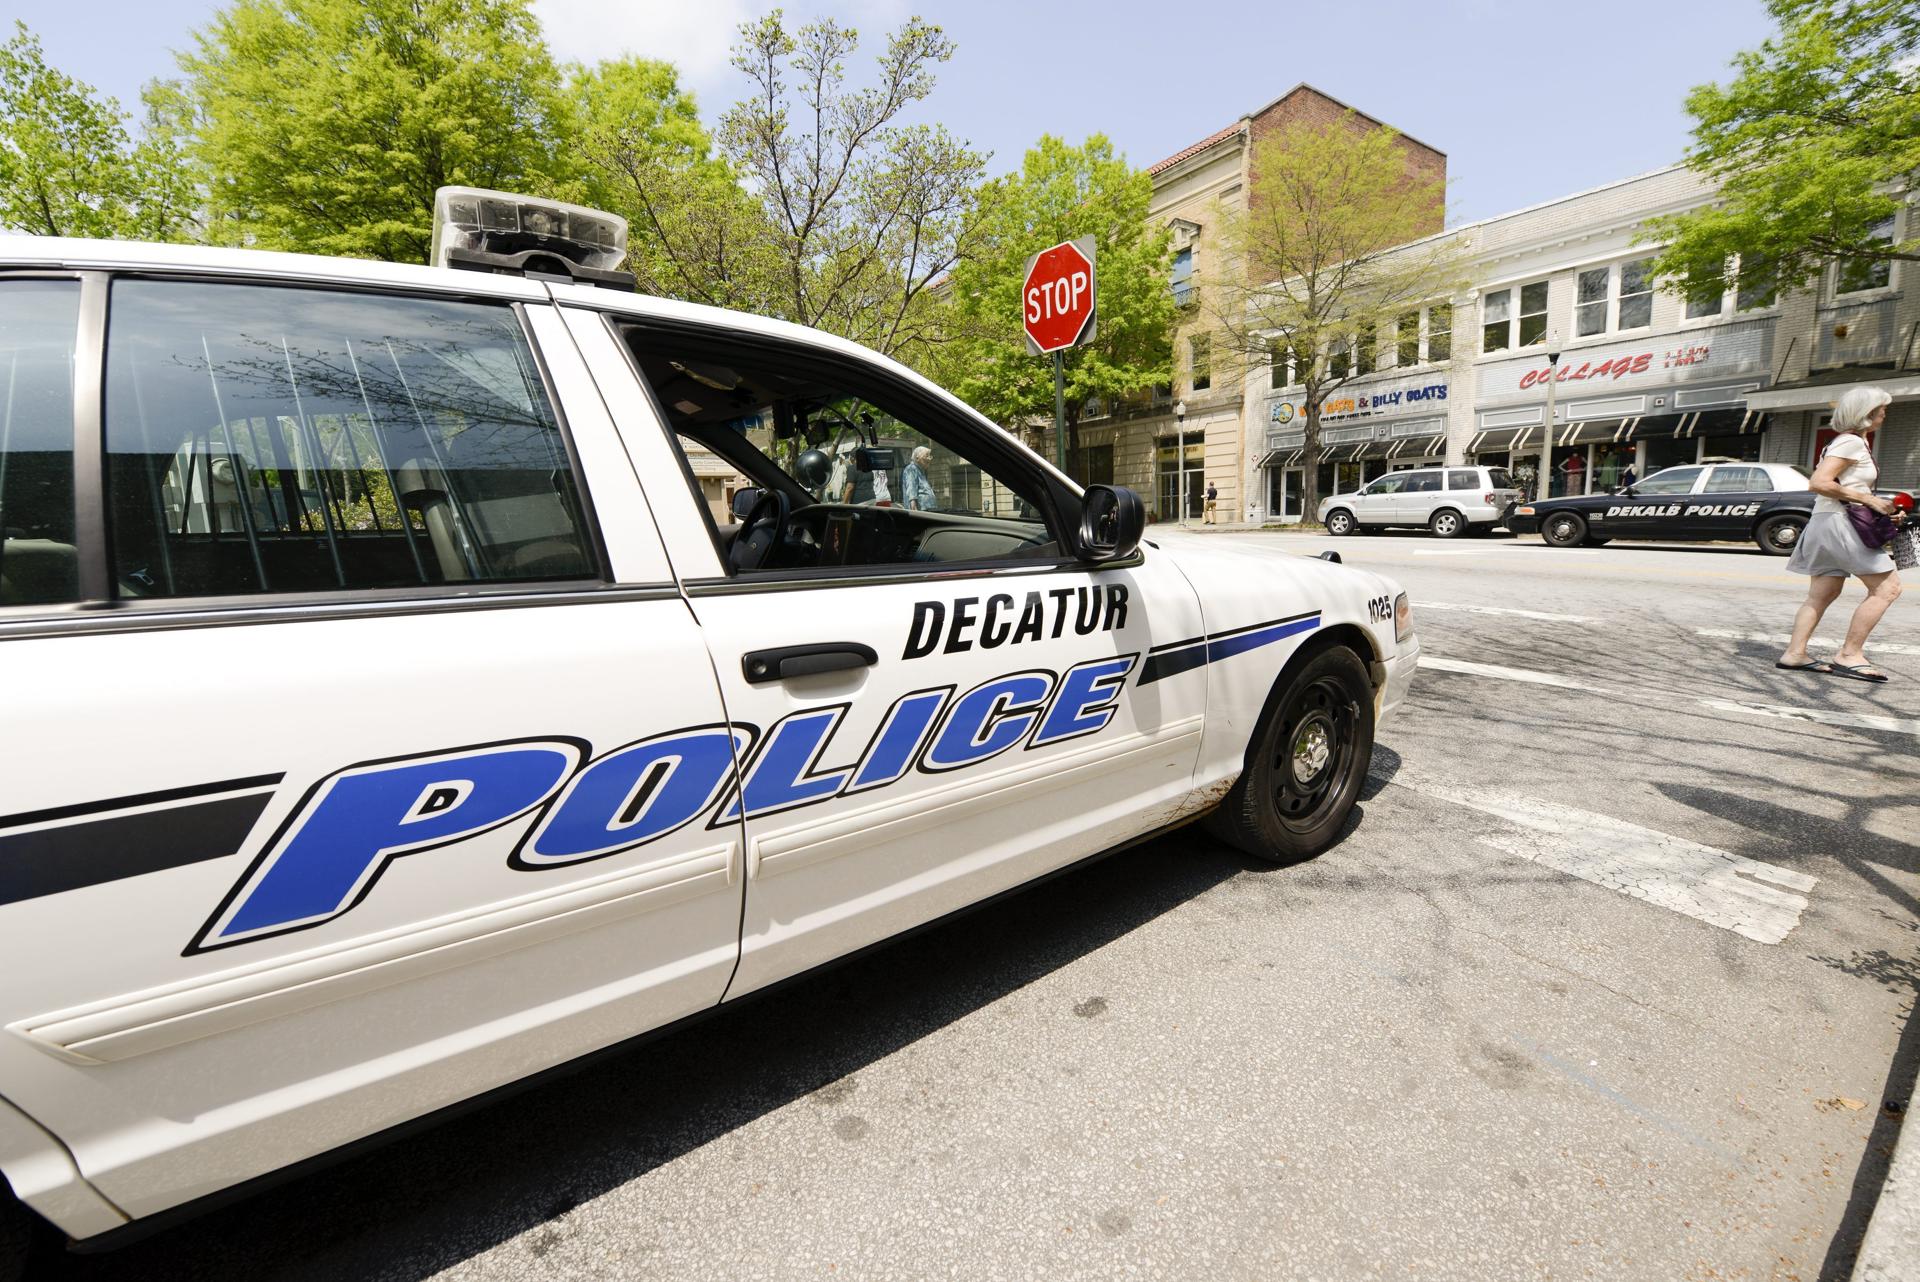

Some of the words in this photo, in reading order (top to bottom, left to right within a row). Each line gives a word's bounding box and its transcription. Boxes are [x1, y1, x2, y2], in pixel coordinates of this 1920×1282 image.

[1027, 271, 1088, 324] STOP
[1519, 352, 1654, 390] COLLAGE
[1358, 397, 1369, 408] &
[1372, 391, 1403, 408] BILLY
[1406, 384, 1448, 402] GOATS
[1605, 505, 1681, 517] DEKALB
[1684, 504, 1761, 517] POLICE
[901, 583, 1129, 661] DECATUR
[1367, 595, 1393, 625] 1025
[181, 651, 1141, 957] POLICE
